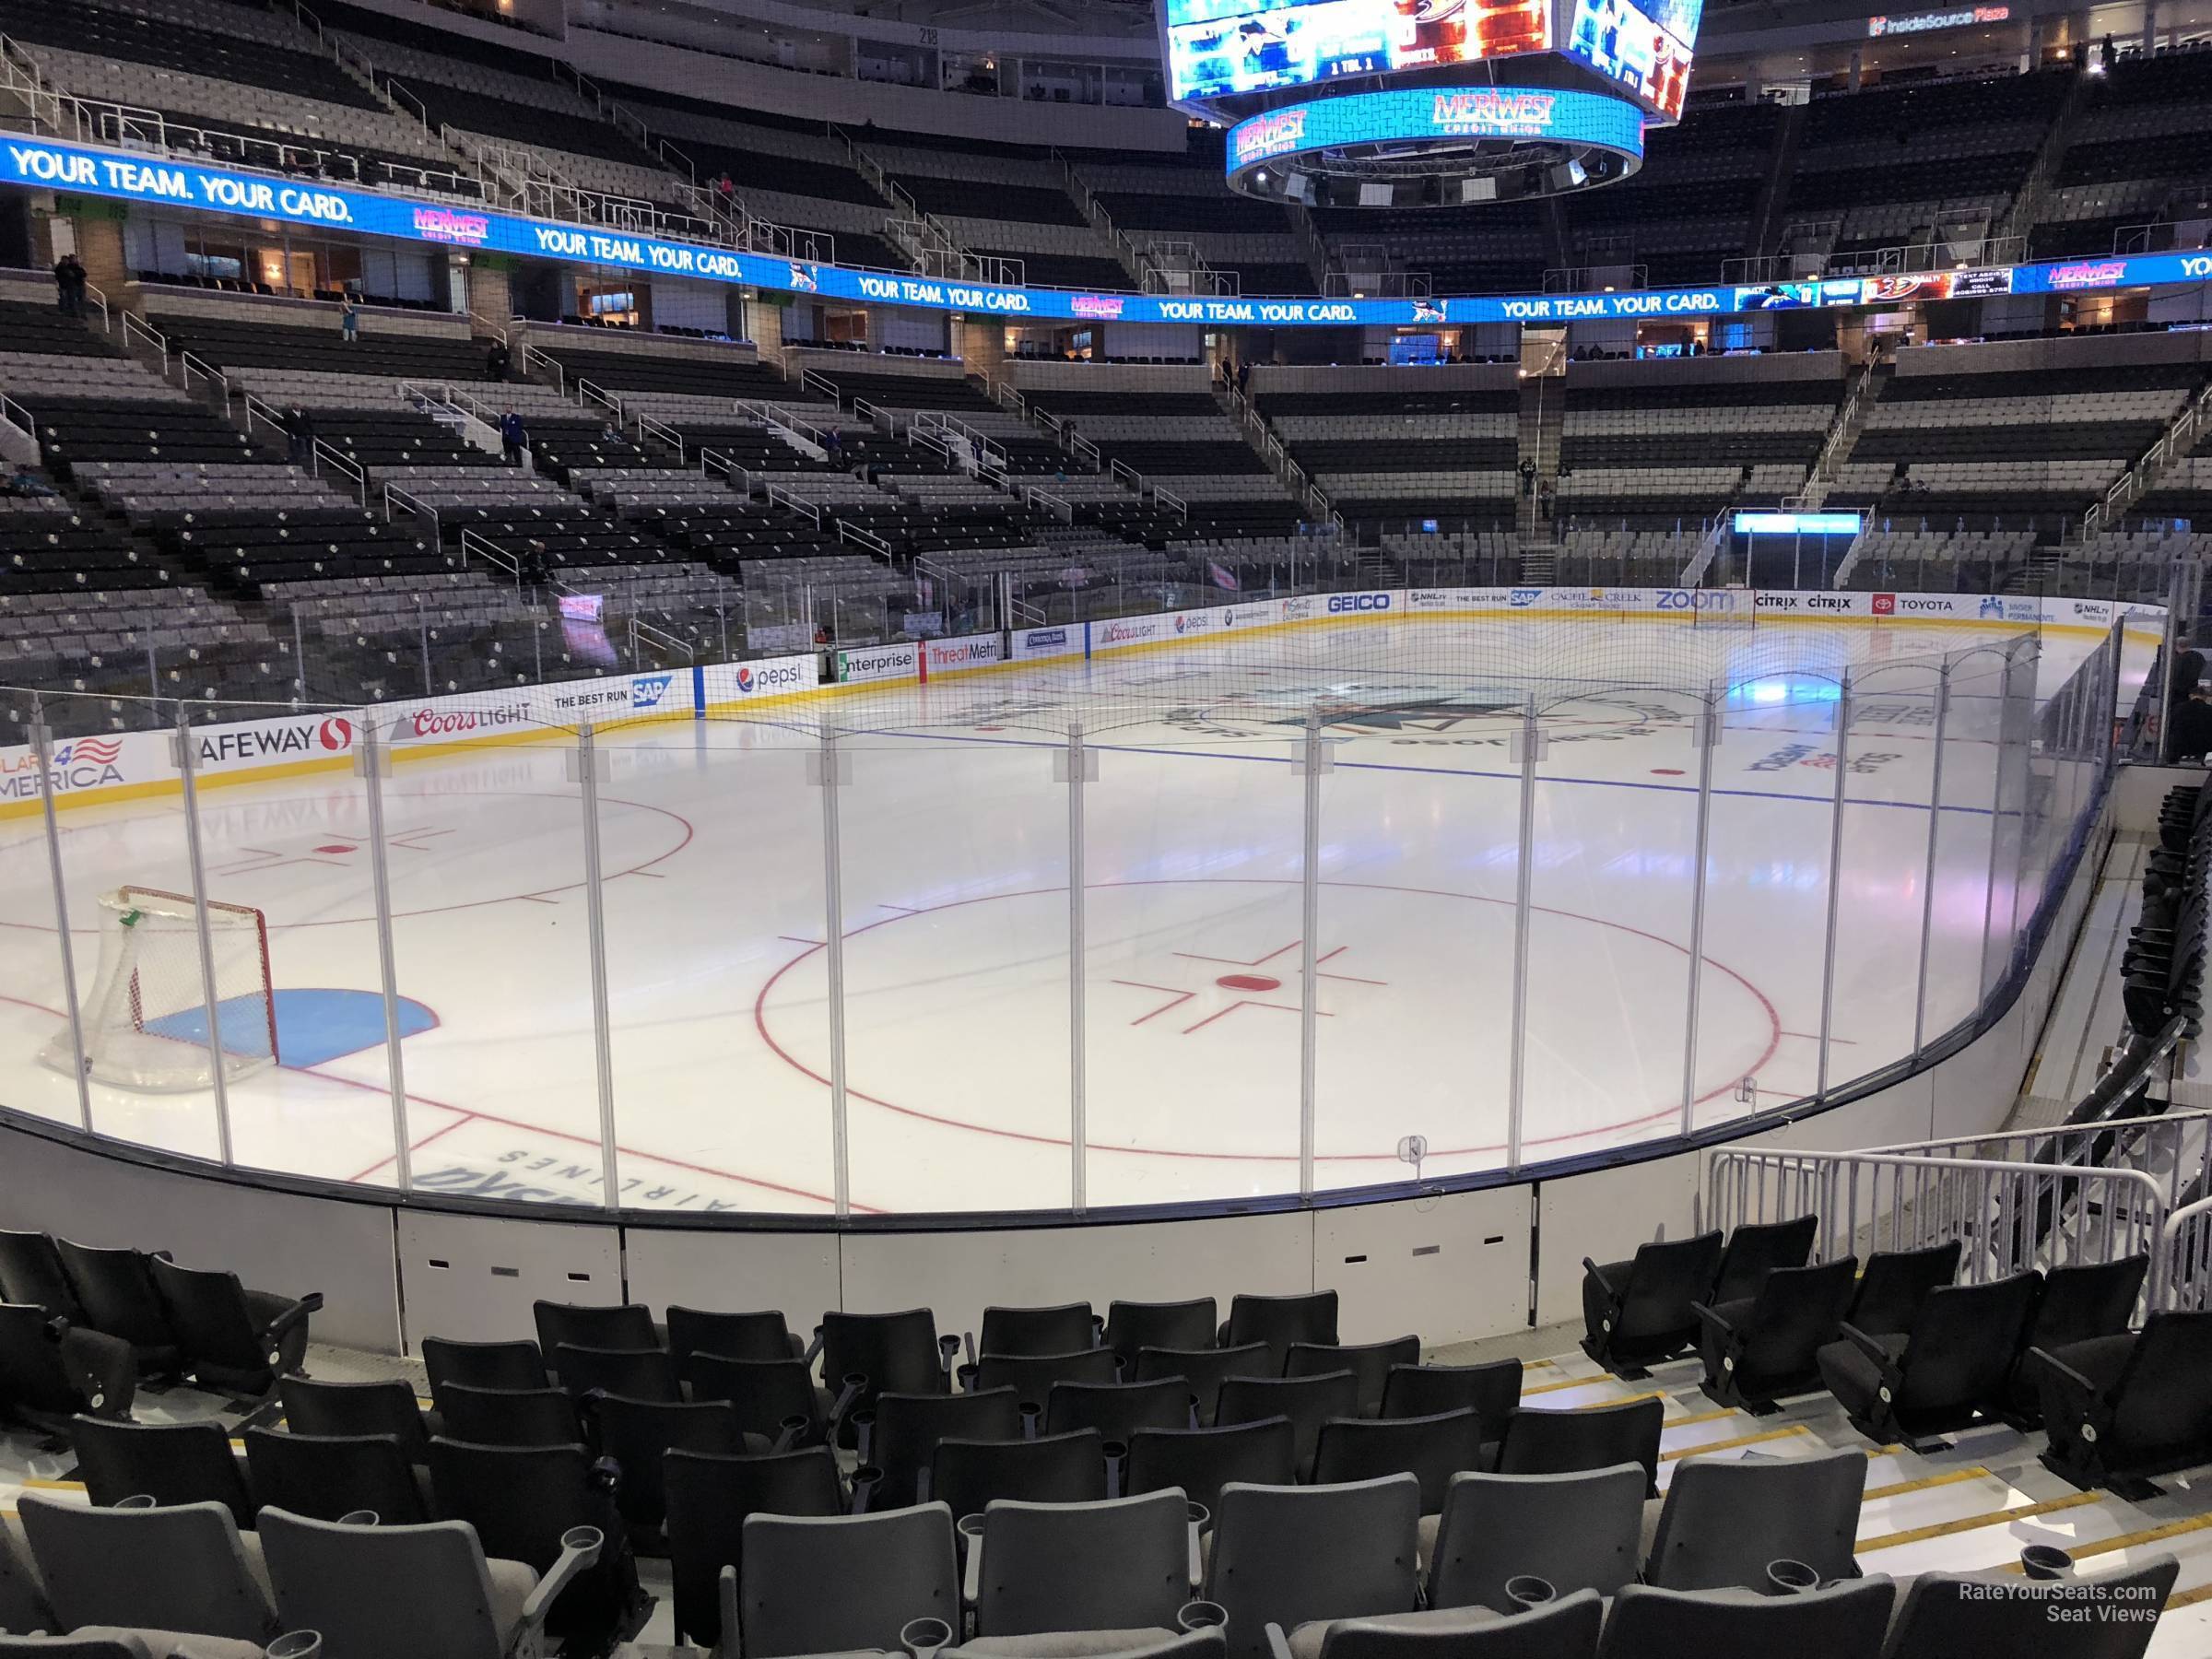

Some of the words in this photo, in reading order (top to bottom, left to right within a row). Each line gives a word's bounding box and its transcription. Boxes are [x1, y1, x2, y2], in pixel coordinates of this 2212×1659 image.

[1974, 6, 2009, 22] Plaza
[1433, 88, 1555, 124] MERIWEST
[1237, 112, 1306, 156] MERIWEST
[9, 146, 99, 186] YOUR
[101, 159, 194, 199] TEAM.
[199, 175, 276, 211] YOUR
[280, 190, 353, 222] CARD.
[415, 208, 489, 238] MERIWEST
[535, 228, 588, 256] YOUR
[590, 236, 644, 264] TEAM.
[648, 245, 693, 270] YOUR
[697, 253, 742, 277] CARD.
[2049, 262, 2127, 283] MERIWEST
[2181, 257, 2212, 276] YO
[858, 276, 899, 299] YOUR
[901, 281, 944, 304] TEAM.
[947, 287, 983, 309] YOUR
[986, 292, 1030, 312] CARD.
[1071, 295, 1124, 313] MERIWEST
[1159, 301, 1203, 320] YOUR
[1206, 303, 1254, 321] TEAM.
[1259, 304, 1303, 321] YOUR
[1308, 304, 1357, 321] CARD.
[1502, 300, 1549, 318] YOUR
[1554, 299, 1607, 316] TEAM.
[1612, 297, 1662, 313] YOUR
[1666, 293, 1720, 311] CARD.
[1328, 594, 1390, 612] GEICO
[1511, 591, 1535, 606] SAP
[1606, 593, 1641, 602] CREEK
[1656, 591, 1734, 610] zoom
[1900, 600, 1953, 612] TOYOTA
[1111, 623, 1135, 641] Coors
[1135, 624, 1156, 638] LIGHT
[1186, 616, 1208, 630] pepsi
[932, 641, 997, 665] ThreatMetri
[759, 664, 802, 689] pepsi
[554, 697, 576, 709] THE
[579, 693, 604, 707] BEST
[607, 690, 628, 702] RUN
[633, 682, 665, 704] SAP
[413, 708, 477, 737] Coors
[479, 702, 532, 728] LIGHT
[201, 725, 315, 761] AFEWAY
[54, 746, 73, 766] 4
[0, 764, 124, 798] MERICA
[499, 1149, 736, 1212] AIRLINES
